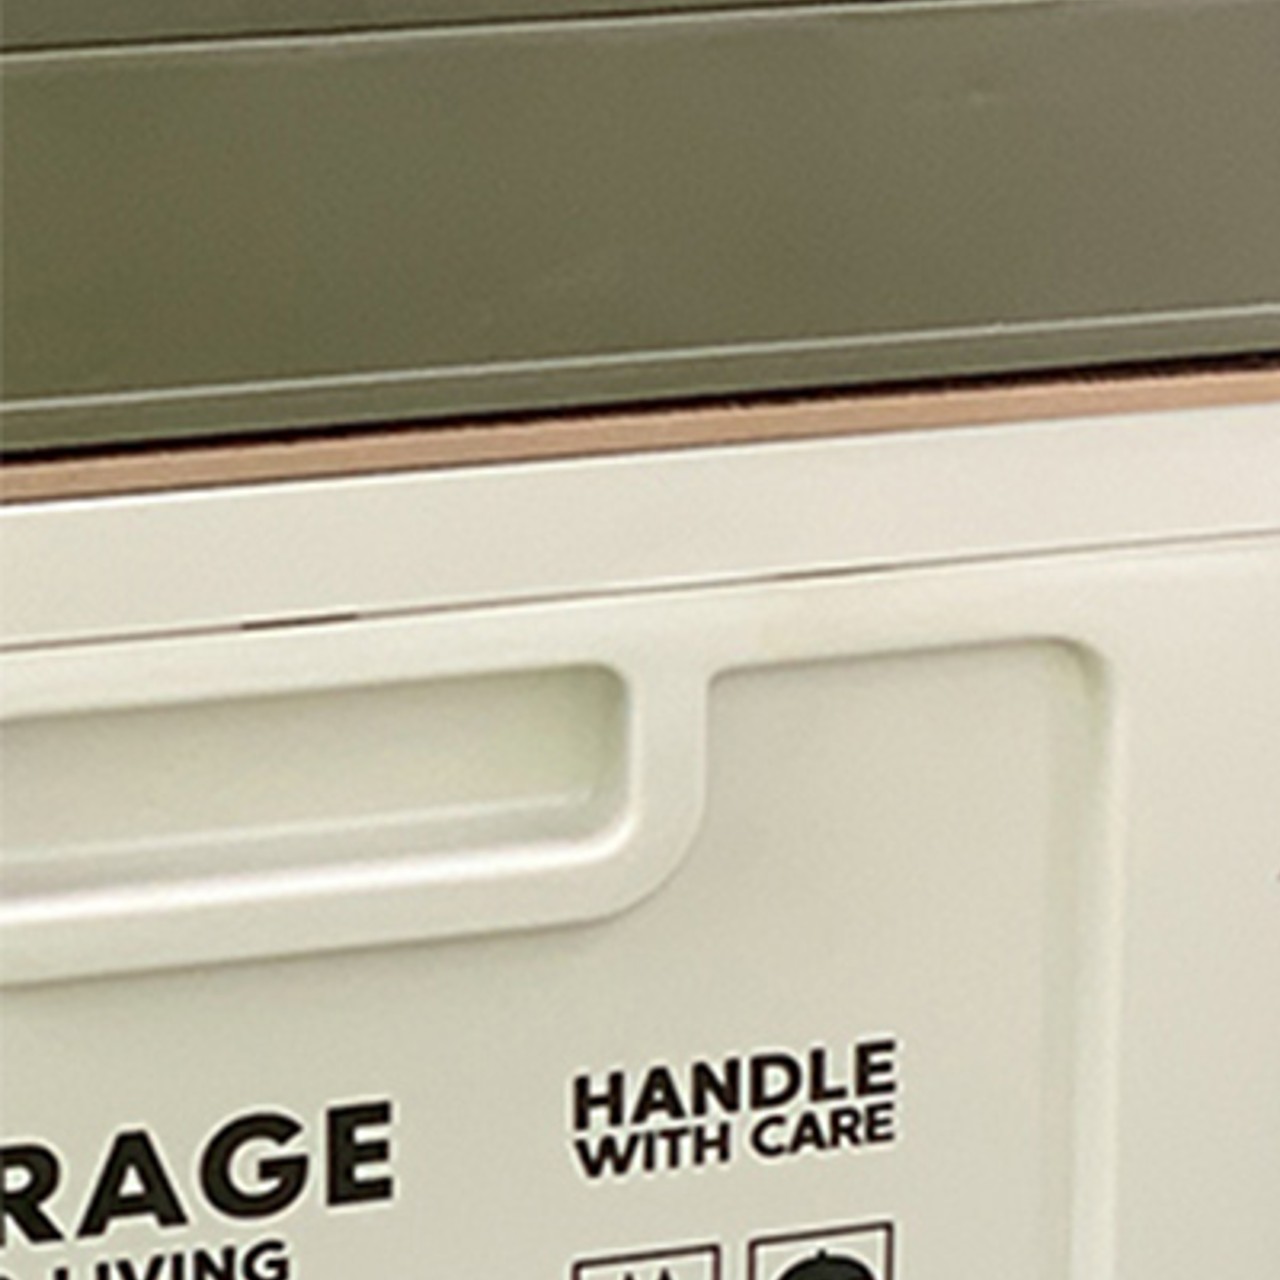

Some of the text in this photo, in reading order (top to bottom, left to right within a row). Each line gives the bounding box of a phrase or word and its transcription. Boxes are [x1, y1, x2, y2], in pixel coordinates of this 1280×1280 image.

[573, 1040, 896, 1131] HANDLE
[0, 1100, 393, 1246] RAGE
[574, 1102, 894, 1178] WITH CARE
